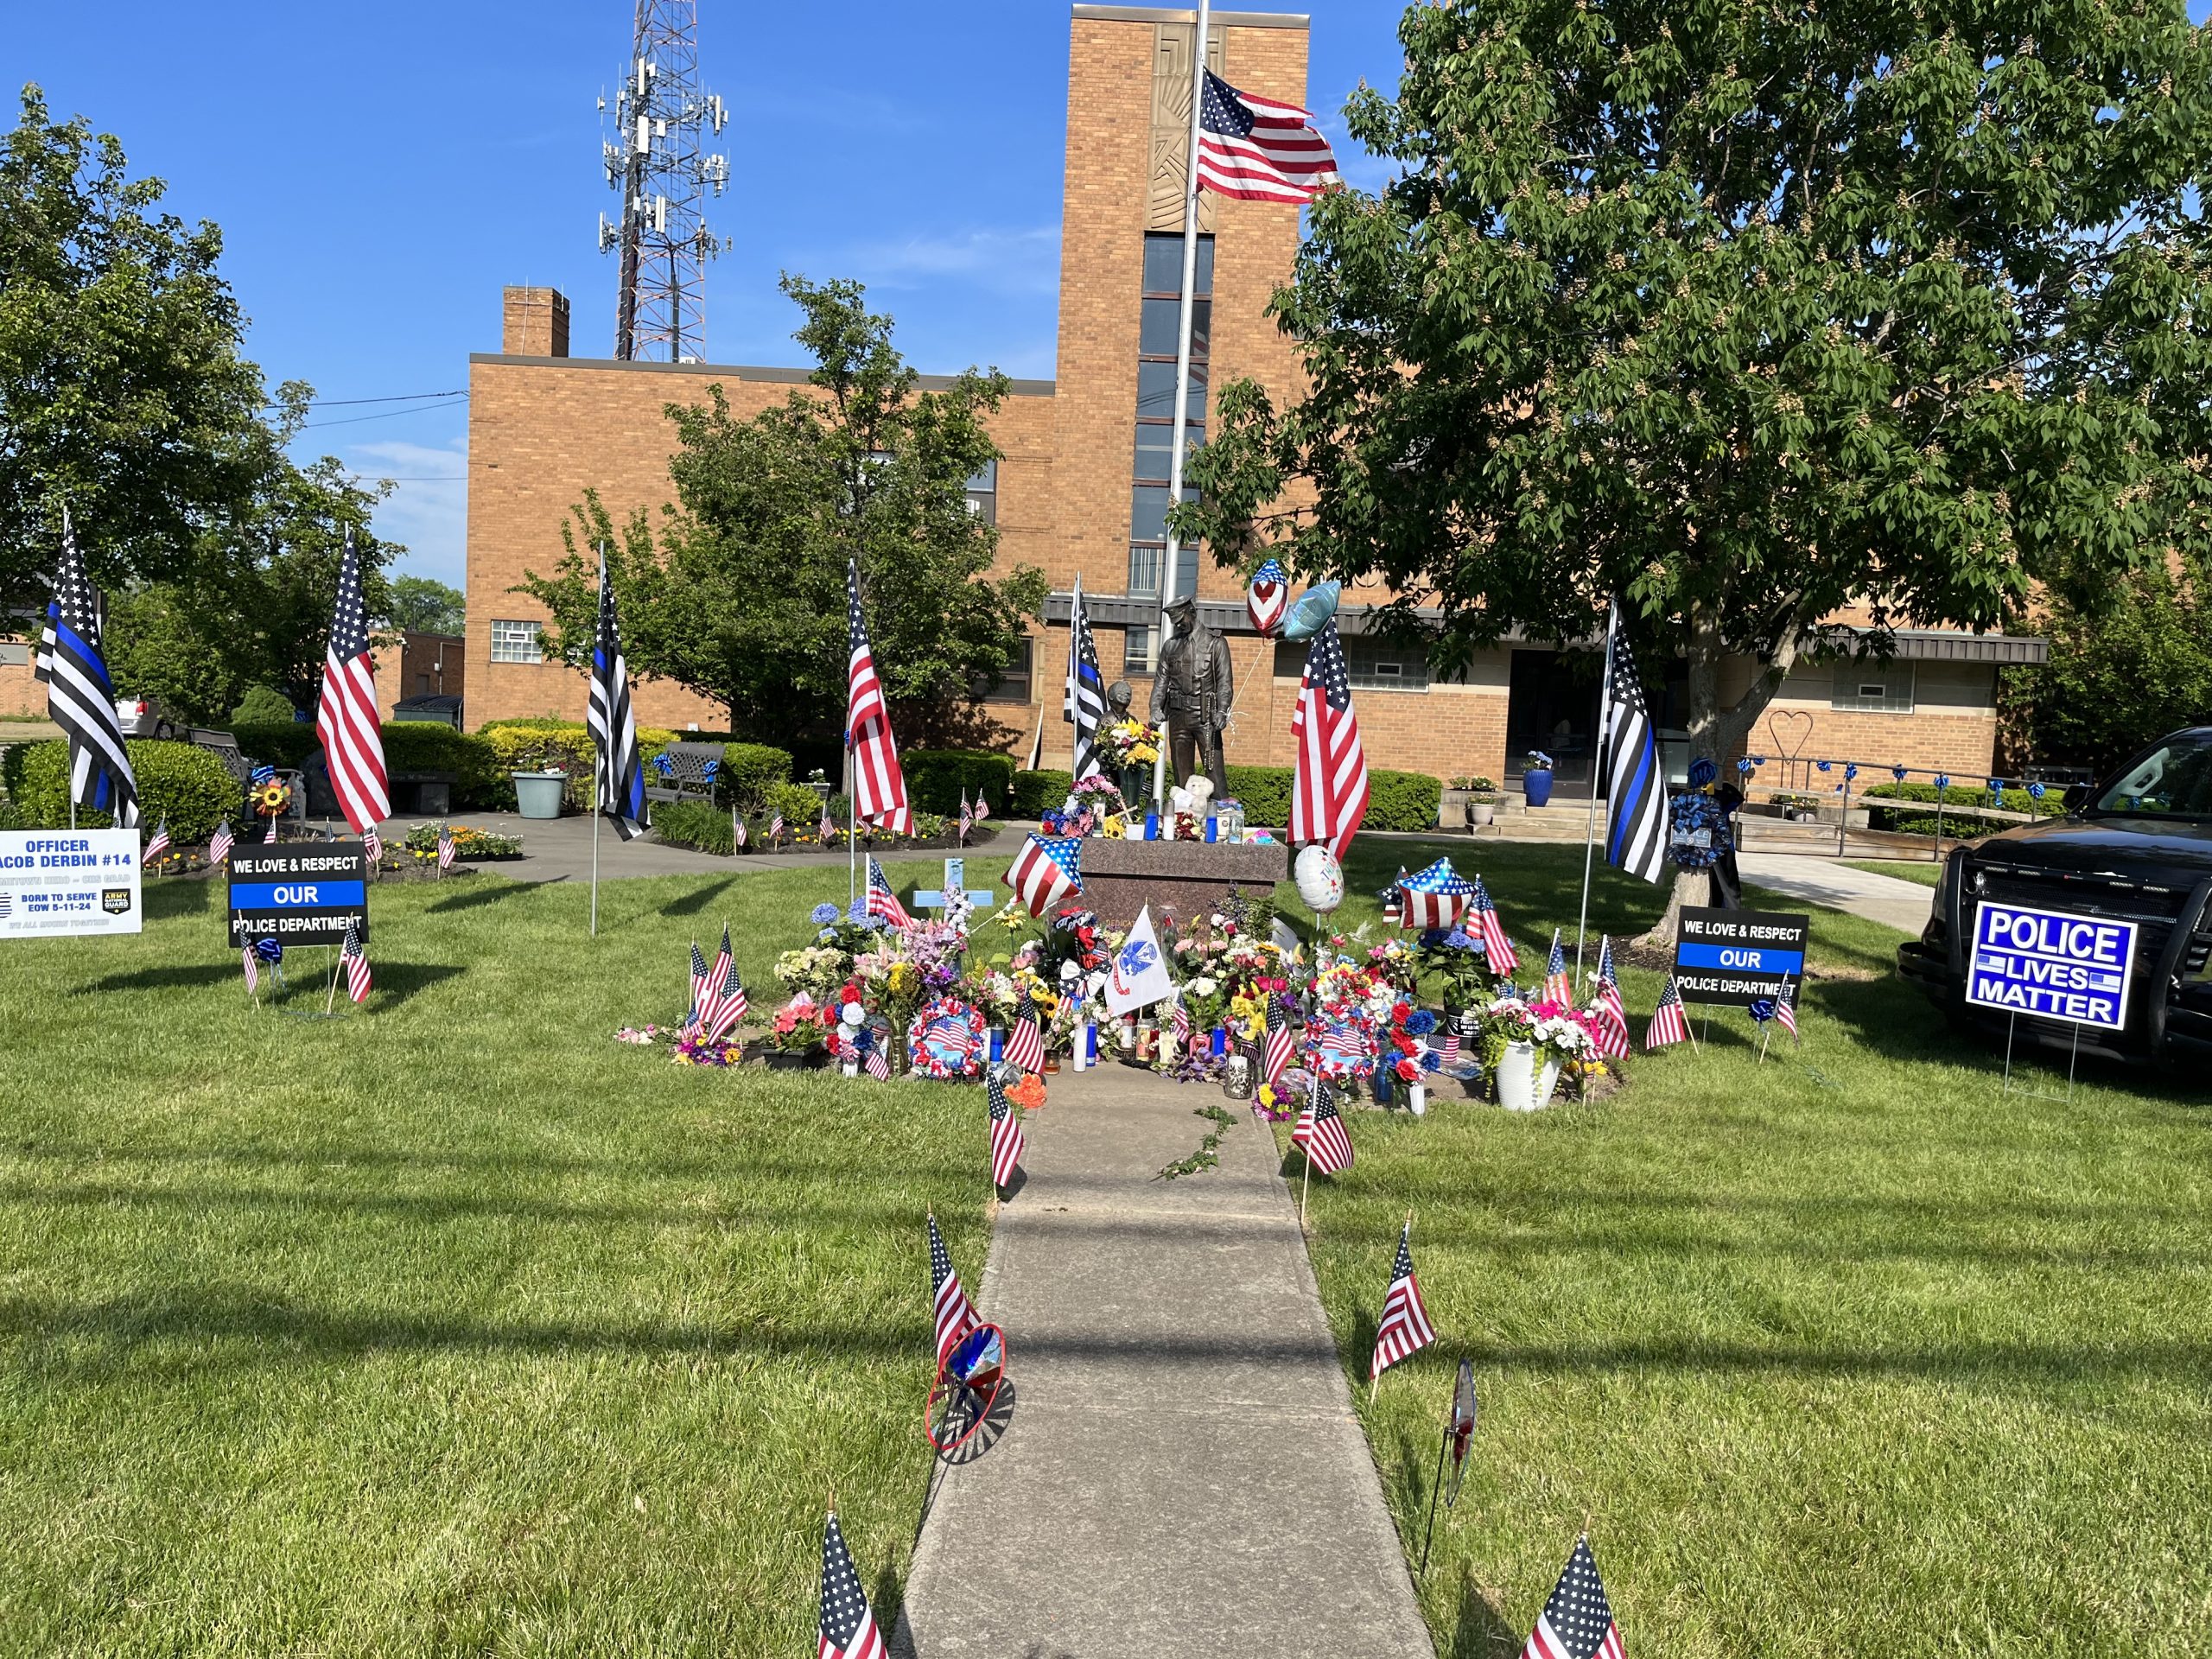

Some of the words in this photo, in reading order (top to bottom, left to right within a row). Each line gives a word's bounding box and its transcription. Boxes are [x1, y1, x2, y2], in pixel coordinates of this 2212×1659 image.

[26, 840, 89, 853] OFFICER
[41, 855, 97, 868] DERBIN
[102, 854, 131, 866] #14
[234, 860, 252, 873] WE
[256, 859, 287, 873] LOVE
[289, 858, 298, 872] &
[302, 856, 358, 871] RESPECT
[22, 893, 48, 903] BORN
[51, 893, 63, 902] TO
[67, 893, 97, 901] SERVE
[273, 886, 319, 904] OUR
[232, 918, 276, 933] POLICE
[279, 916, 362, 932] DEPARTMENT
[1685, 920, 1703, 933] WE
[1706, 922, 1737, 937] LOVE
[1738, 925, 1747, 938] &
[1750, 925, 1802, 941] RESPECT
[1987, 911, 2120, 963] POLICE
[1719, 950, 1762, 969] OUR
[2005, 957, 2088, 990] LIVES
[1676, 976, 1719, 991] POLICE
[1720, 980, 1796, 996] DEPARTMET
[1977, 978, 2113, 1022] MATTER
